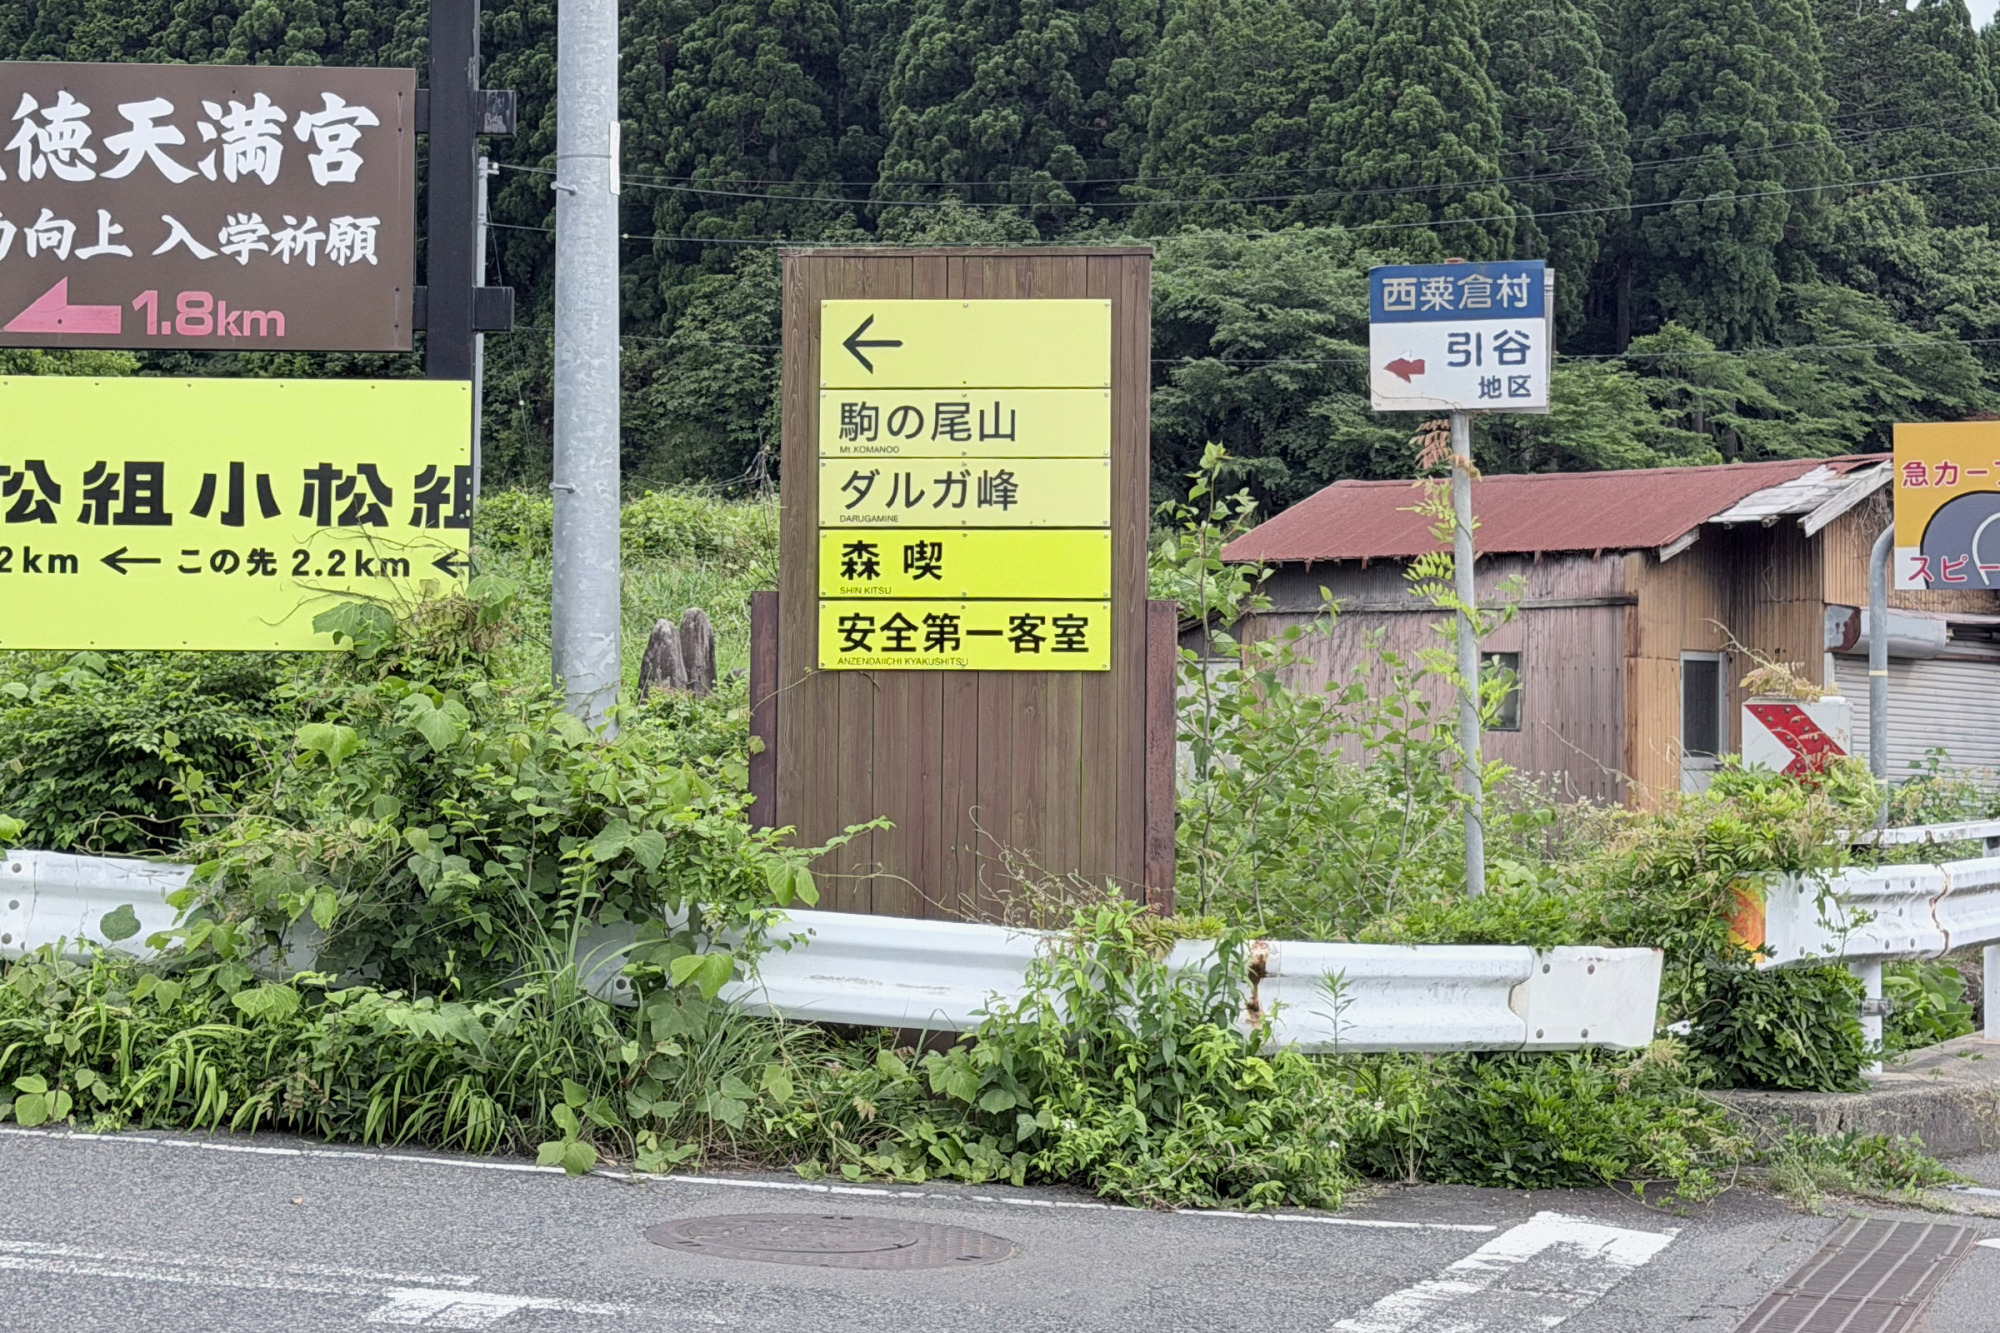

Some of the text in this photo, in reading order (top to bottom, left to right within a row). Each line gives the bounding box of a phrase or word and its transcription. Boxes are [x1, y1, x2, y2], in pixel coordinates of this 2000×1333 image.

[0, 91, 380, 187] 徳天満宮
[152, 212, 381, 267] 入学祈願
[1382, 273, 1532, 312] 西粟倉村
[132, 290, 286, 338] 1.8km
[1447, 329, 1531, 368] 引谷
[1478, 375, 1532, 400] 地区
[839, 401, 1016, 442] 駒の尾山
[840, 469, 1019, 511] ダルガ峰
[1902, 461, 2000, 487] 急カー
[839, 514, 899, 523] DARUGAMINE
[177, 547, 277, 577] この先
[840, 586, 892, 595] SHIN KITSU
[837, 612, 1090, 654] 安全第一客室
